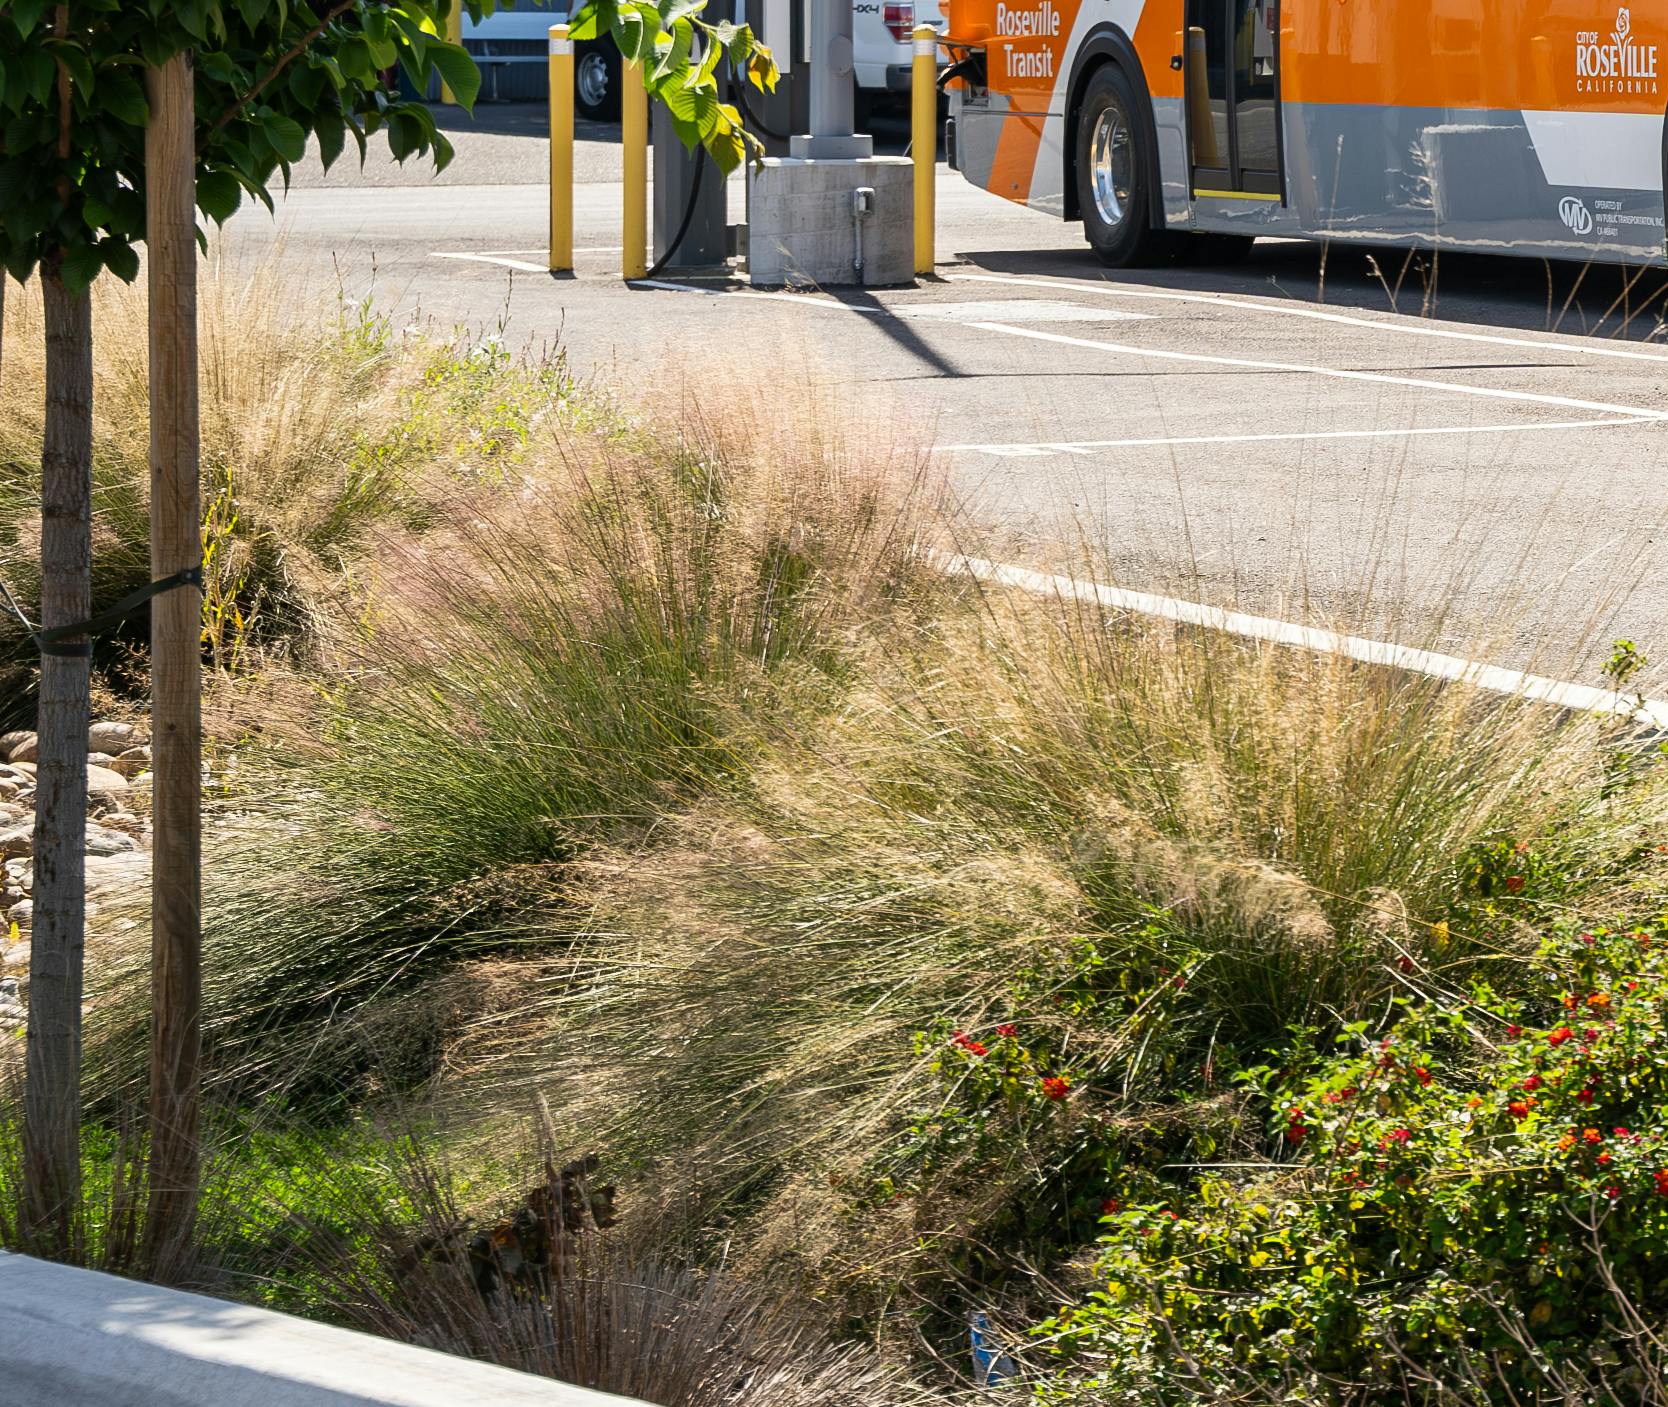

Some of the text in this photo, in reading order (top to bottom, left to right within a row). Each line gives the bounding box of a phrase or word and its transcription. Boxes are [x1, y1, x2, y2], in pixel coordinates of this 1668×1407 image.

[997, 1, 1060, 37] Roseville
[1576, 32, 1598, 44] CITY OF
[1004, 43, 1053, 77] Transit
[1576, 33, 1657, 78] ROSEVILLE
[1576, 80, 1657, 94] CALIFORNIA
